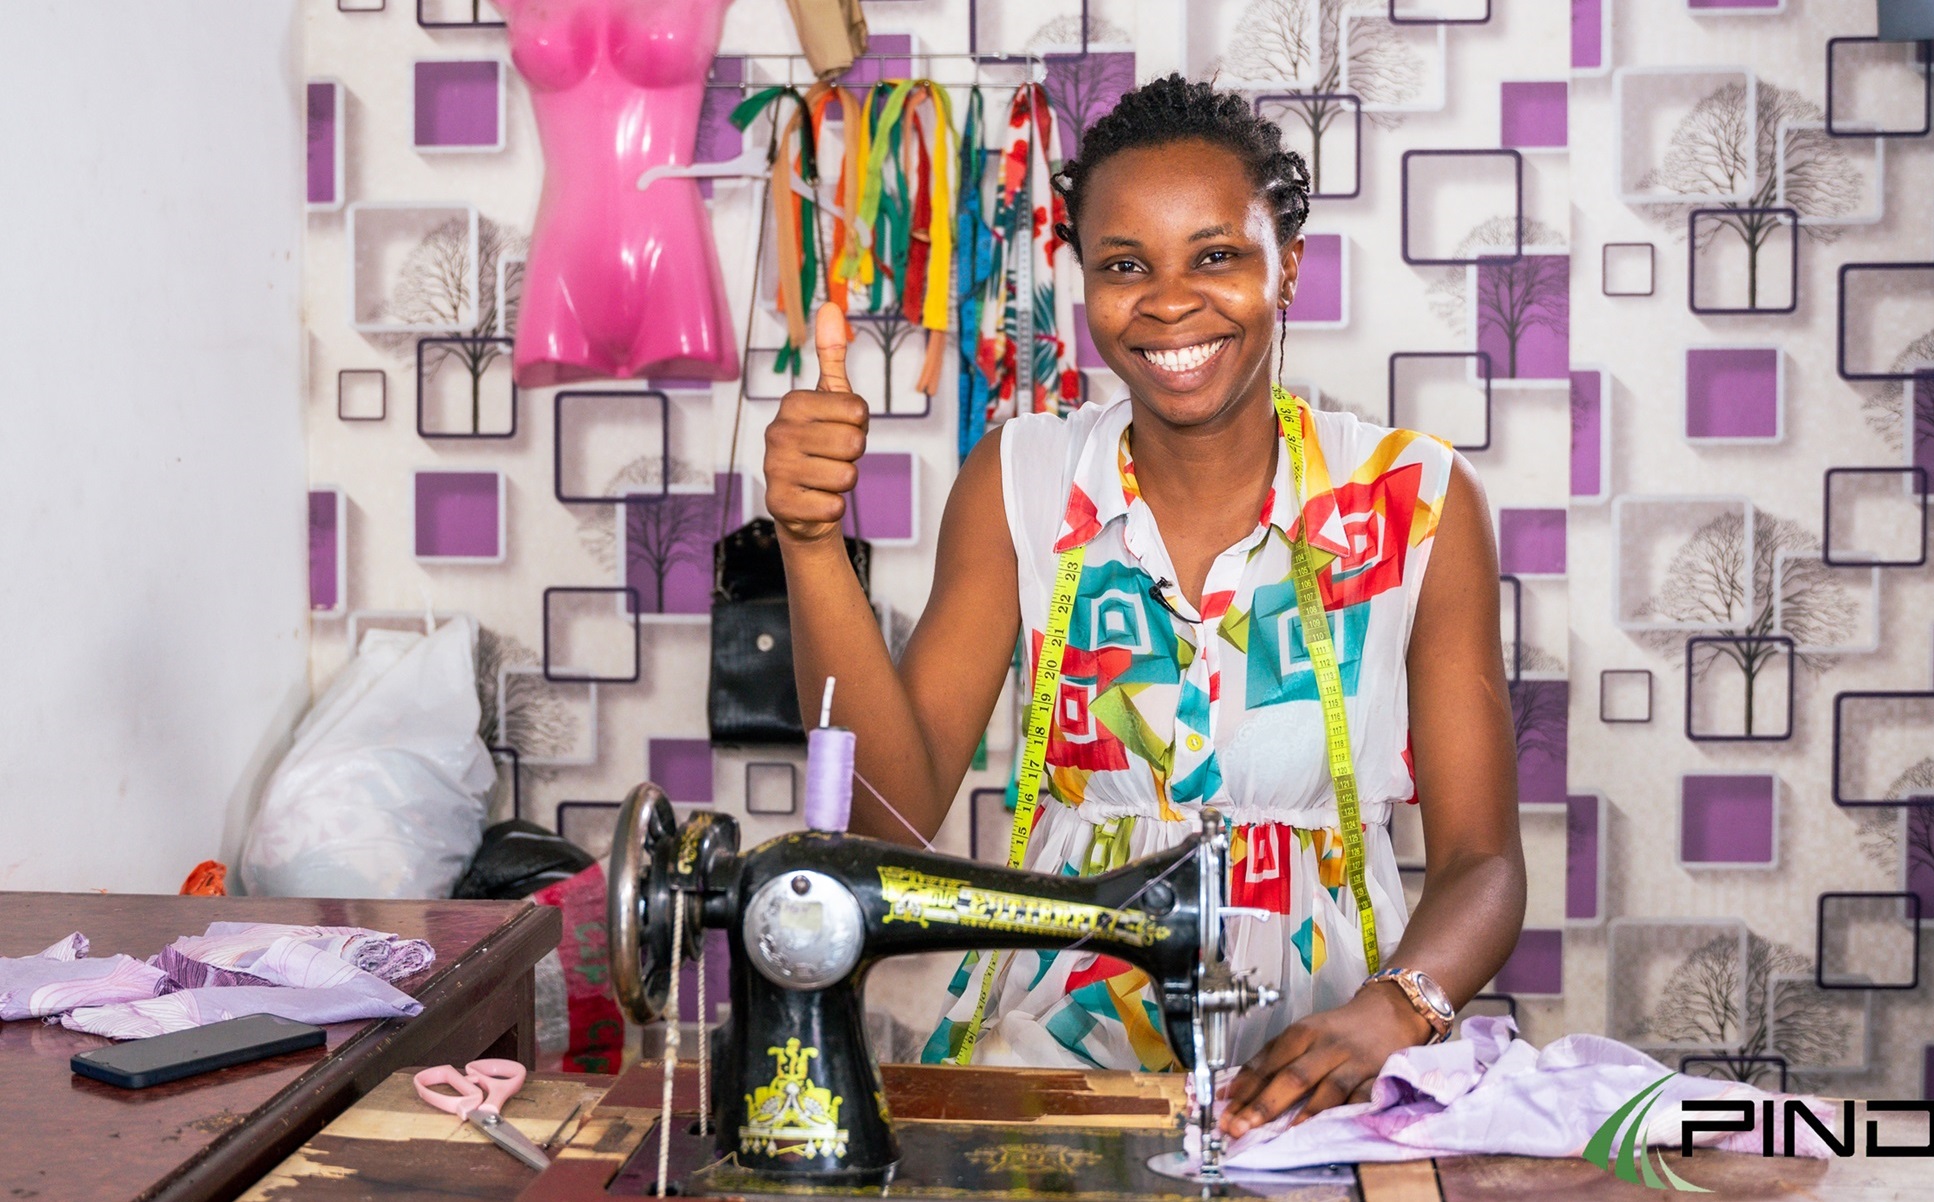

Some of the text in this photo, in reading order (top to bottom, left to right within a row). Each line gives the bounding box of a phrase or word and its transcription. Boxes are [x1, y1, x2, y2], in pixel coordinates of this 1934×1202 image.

[1280, 407, 1294, 423] 36
[1287, 433, 1298, 453] 37
[1065, 562, 1079, 581] 23
[1298, 566, 1308, 576] 105
[1301, 579, 1312, 589] 106
[1303, 592, 1314, 601] 107
[1057, 594, 1071, 614] 22
[1306, 605, 1318, 615] 108
[1309, 619, 1320, 628] 109
[1051, 629, 1065, 647] 21
[1312, 632, 1324, 641] 110
[1316, 646, 1327, 654] 111
[1319, 659, 1330, 667] 112
[1044, 660, 1057, 680] 20
[1323, 672, 1334, 680] 113
[1325, 685, 1337, 694] 114
[1039, 693, 1052, 713] 19
[1328, 699, 1338, 707] 115
[1330, 712, 1341, 720] 116
[1332, 726, 1342, 735] 117
[1033, 726, 1046, 746] 18
[1334, 740, 1344, 748] 118
[1335, 753, 1345, 761] 119
[1028, 760, 1040, 779] 17
[1337, 766, 1348, 774] 120
[1340, 780, 1350, 789] 121
[1023, 793, 1034, 812] 16
[1342, 794, 1353, 802] 122
[1344, 807, 1354, 815] 123
[1346, 820, 1356, 829] 124
[1016, 827, 1027, 846] 15
[1348, 833, 1359, 842] 125
